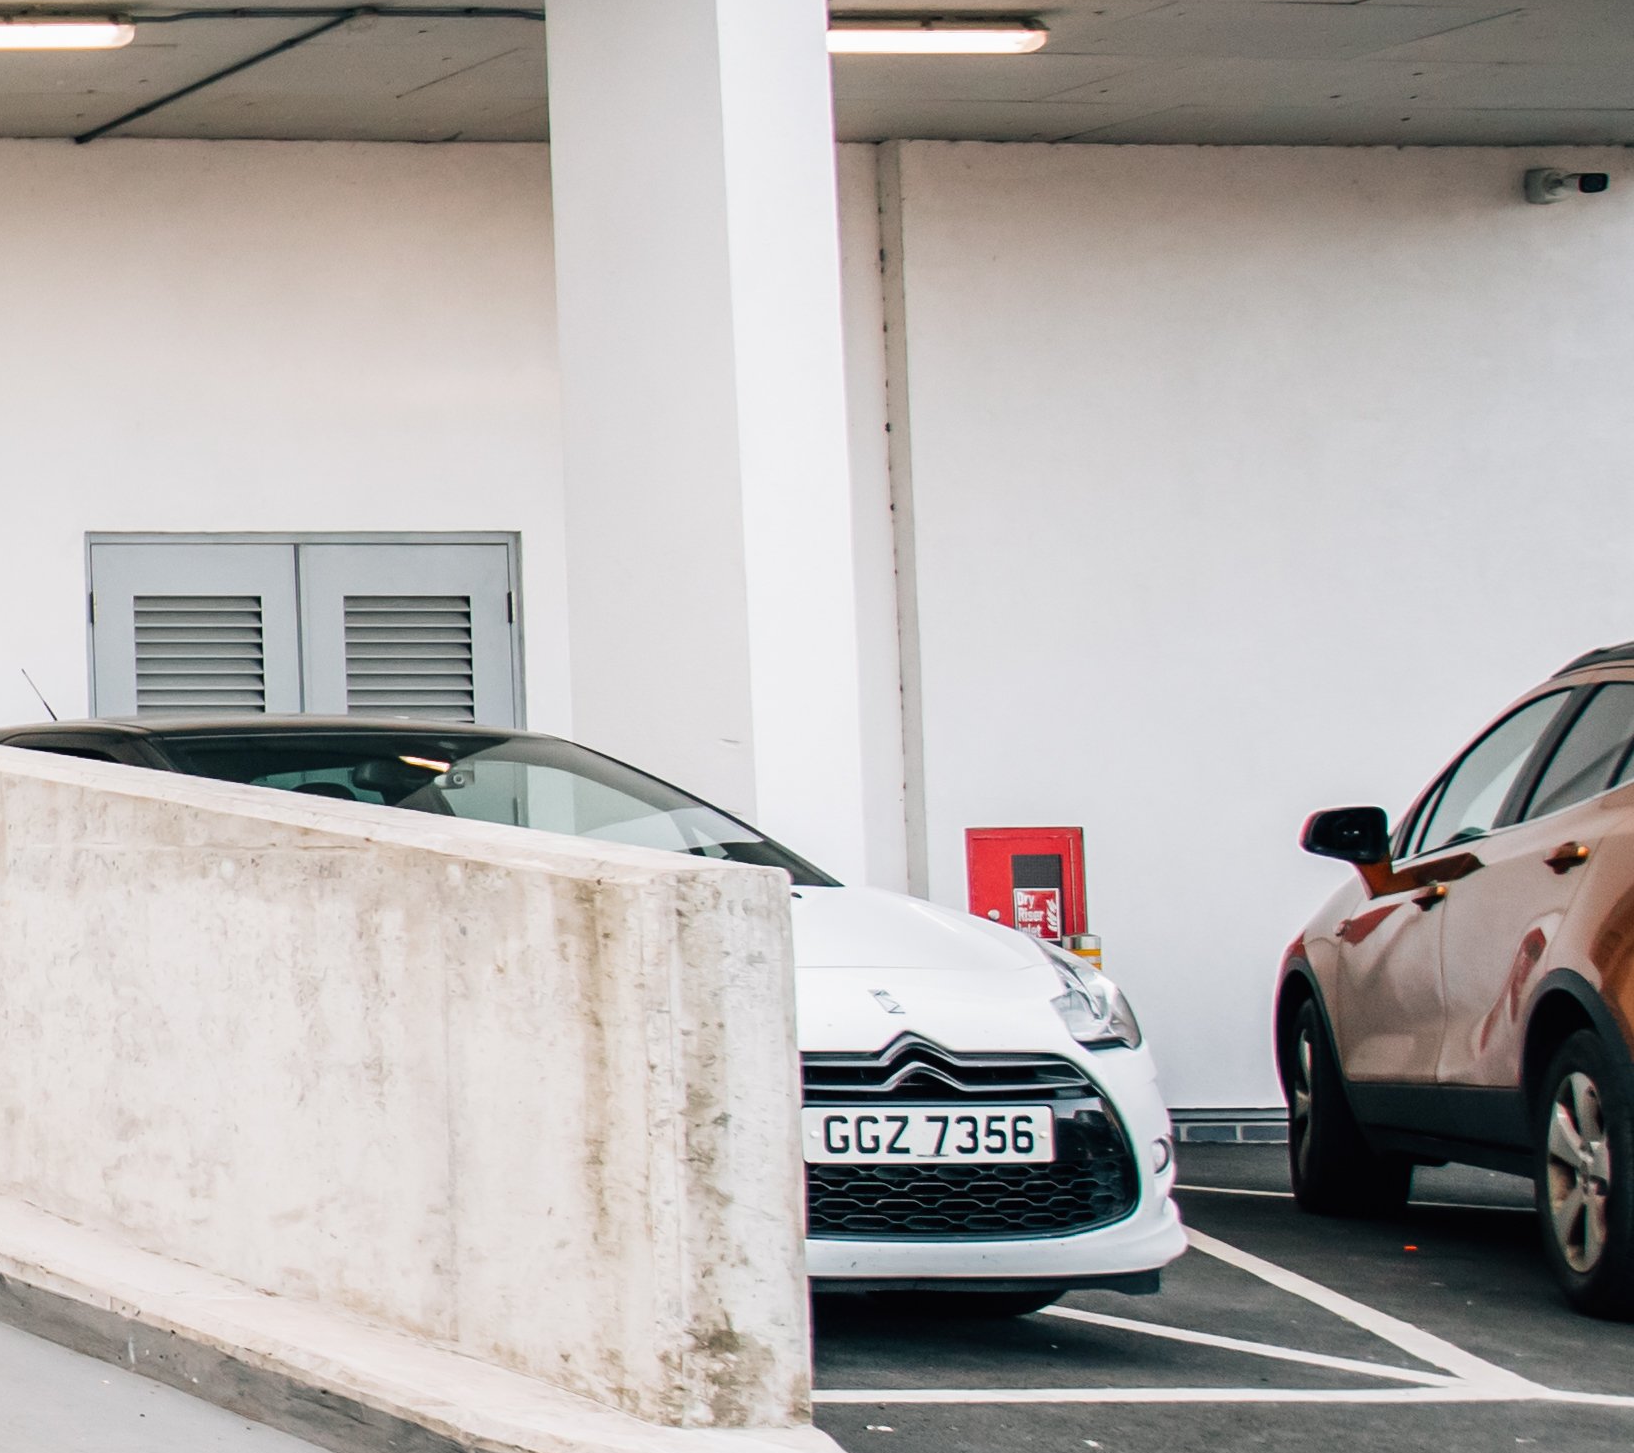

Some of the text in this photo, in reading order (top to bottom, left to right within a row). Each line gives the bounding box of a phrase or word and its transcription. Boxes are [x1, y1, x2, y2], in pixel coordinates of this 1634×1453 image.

[1018, 891, 1035, 909] Dry
[1018, 907, 1044, 922] Riser
[823, 1115, 1034, 1156] GGZ 7356
